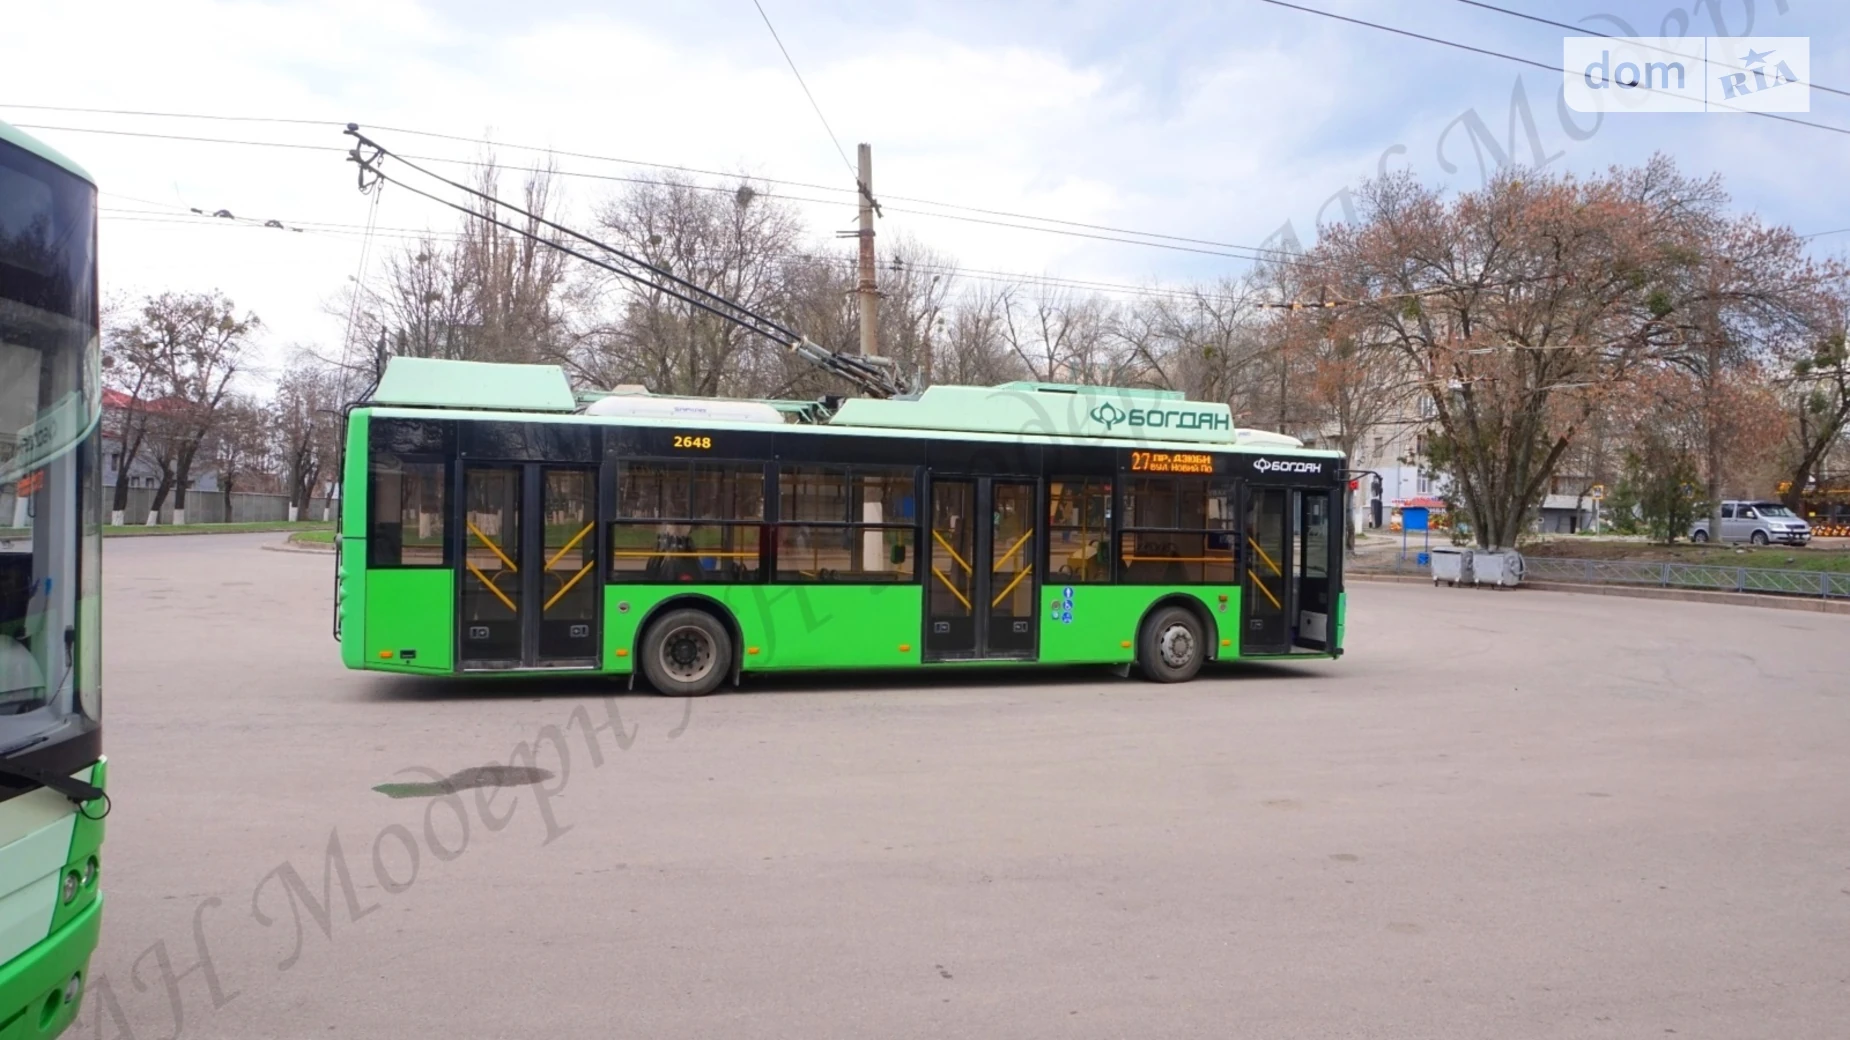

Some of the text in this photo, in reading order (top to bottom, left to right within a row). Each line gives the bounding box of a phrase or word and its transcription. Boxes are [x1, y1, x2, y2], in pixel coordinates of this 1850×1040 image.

[1128, 409, 1230, 431] БОГДАН
[673, 435, 712, 449] 2648
[1132, 453, 1152, 472] 27
[1271, 460, 1322, 473] БОГДАН
